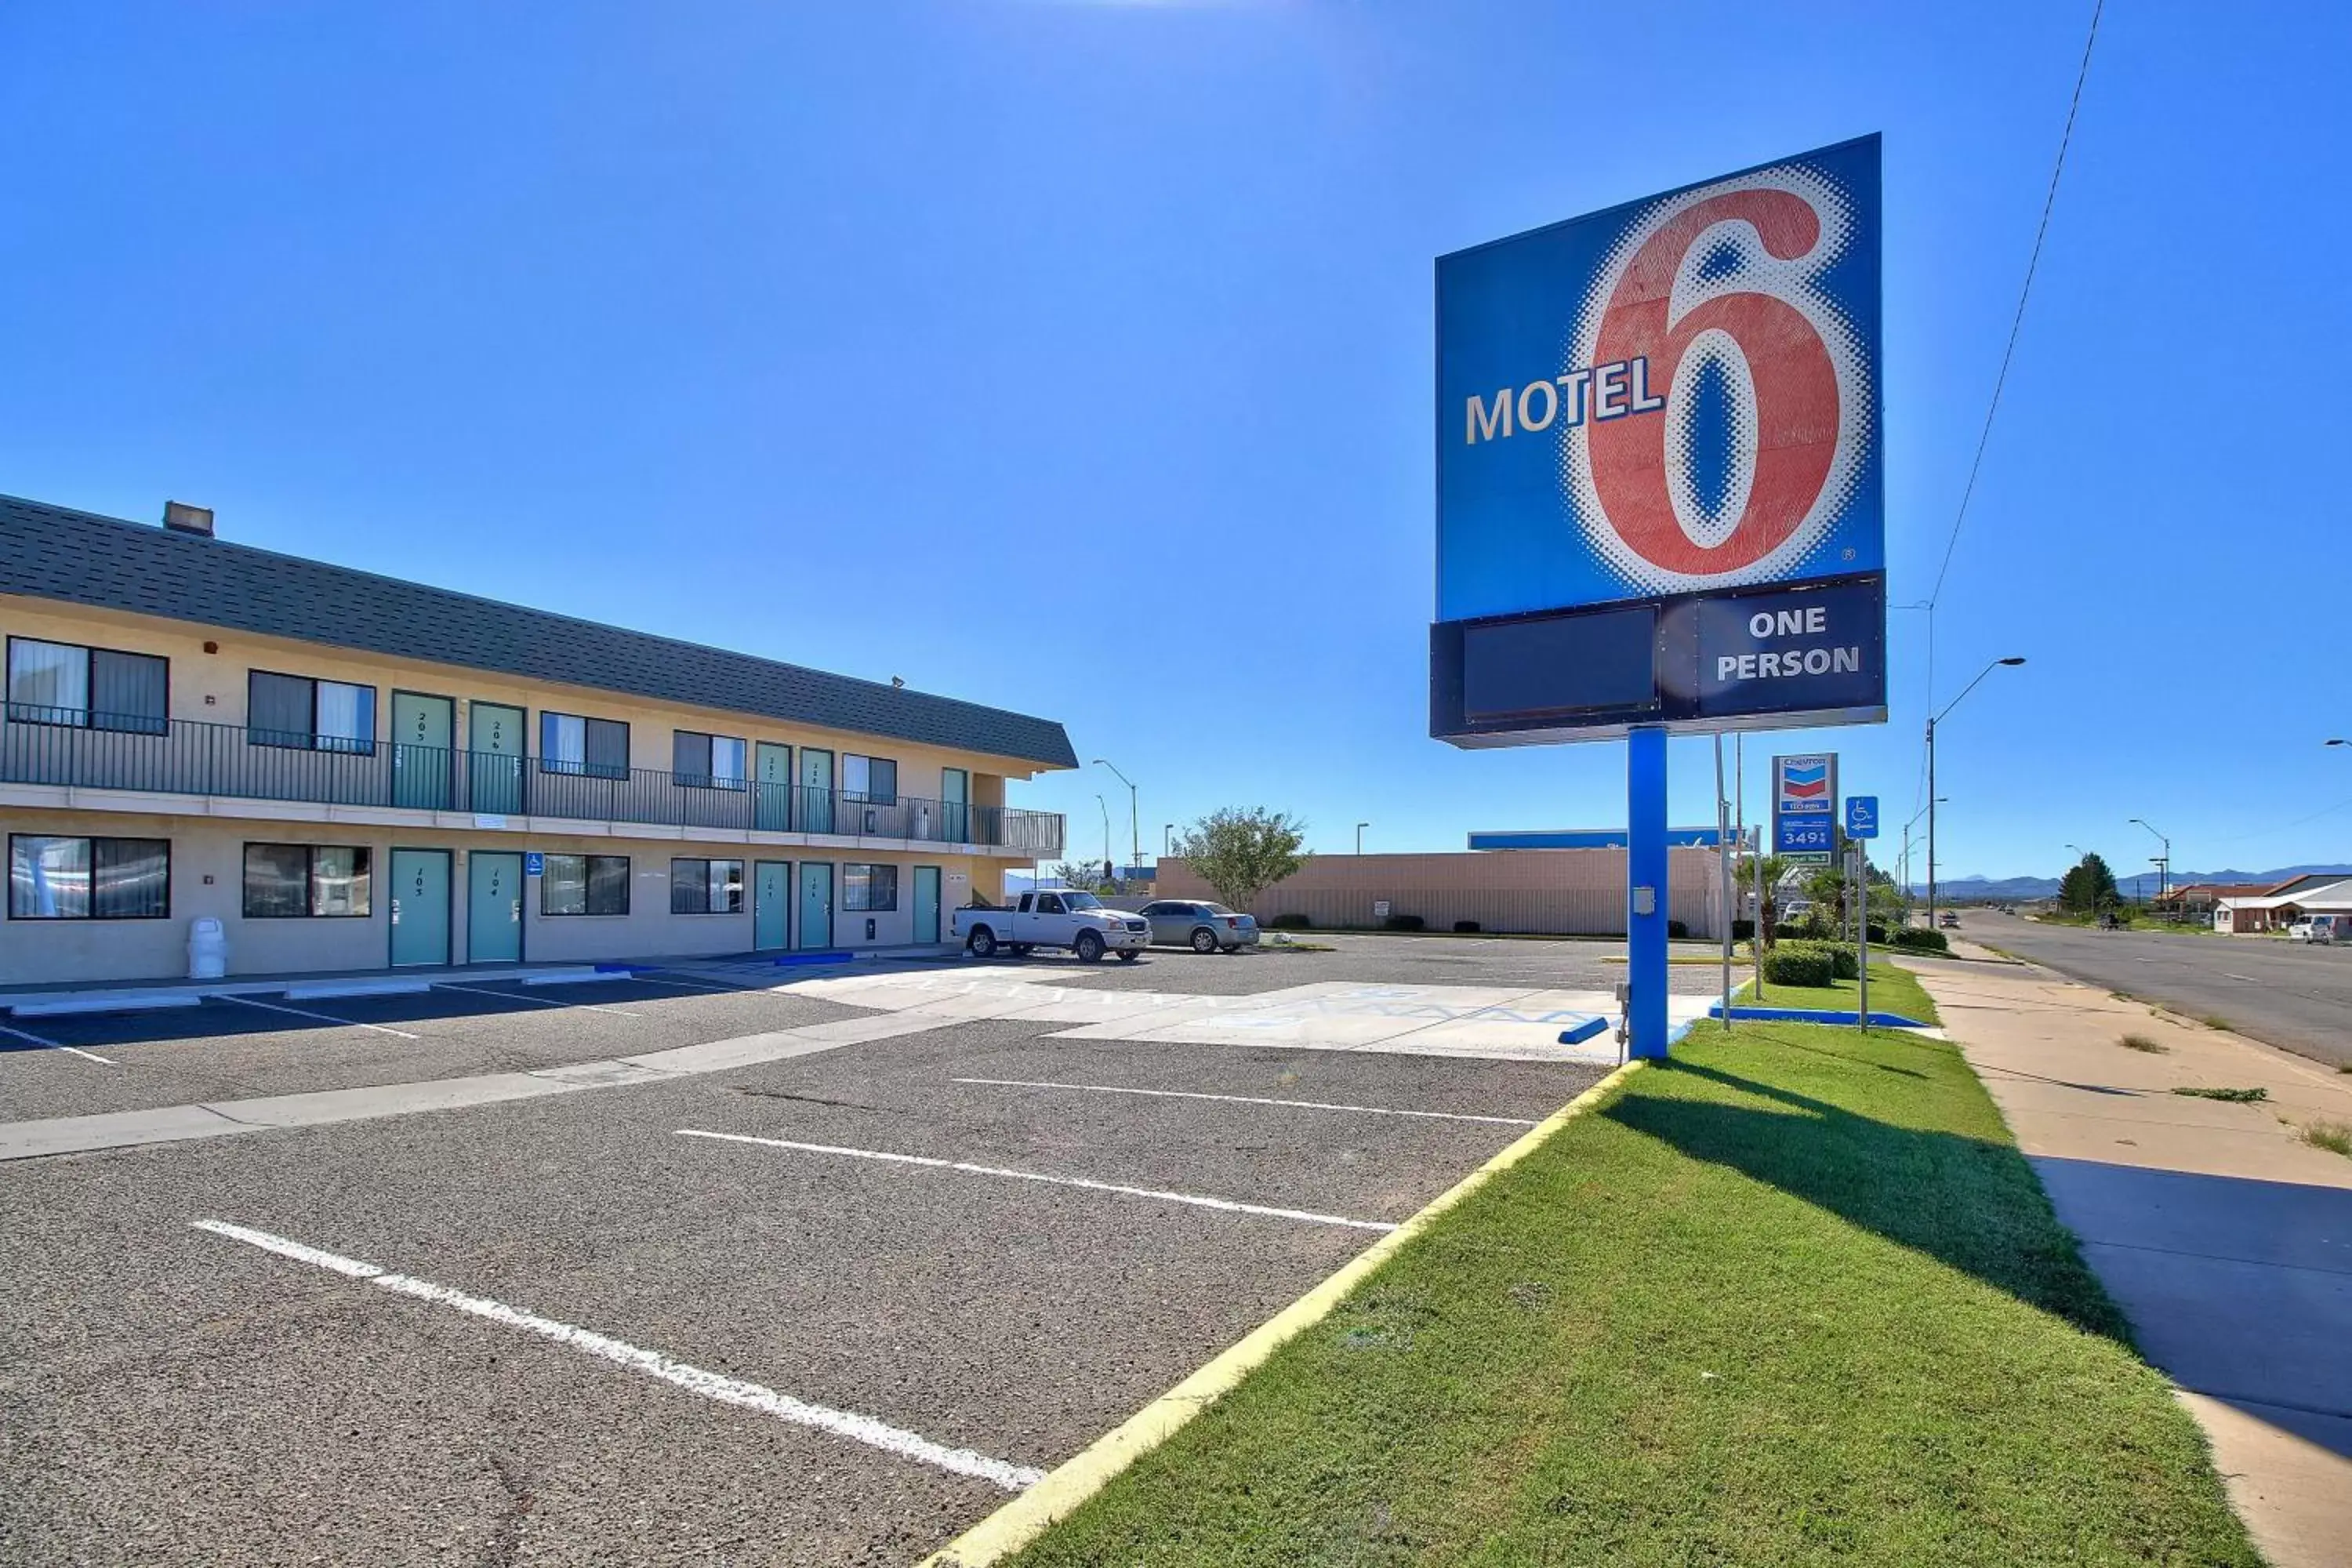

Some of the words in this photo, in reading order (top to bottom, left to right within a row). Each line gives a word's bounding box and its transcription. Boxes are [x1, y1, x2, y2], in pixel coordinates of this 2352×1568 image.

[1466, 358, 1664, 445] MOTEL
[1588, 188, 1840, 576] 6
[1749, 607, 1826, 638] ONE
[1718, 647, 1859, 681] PERSON
